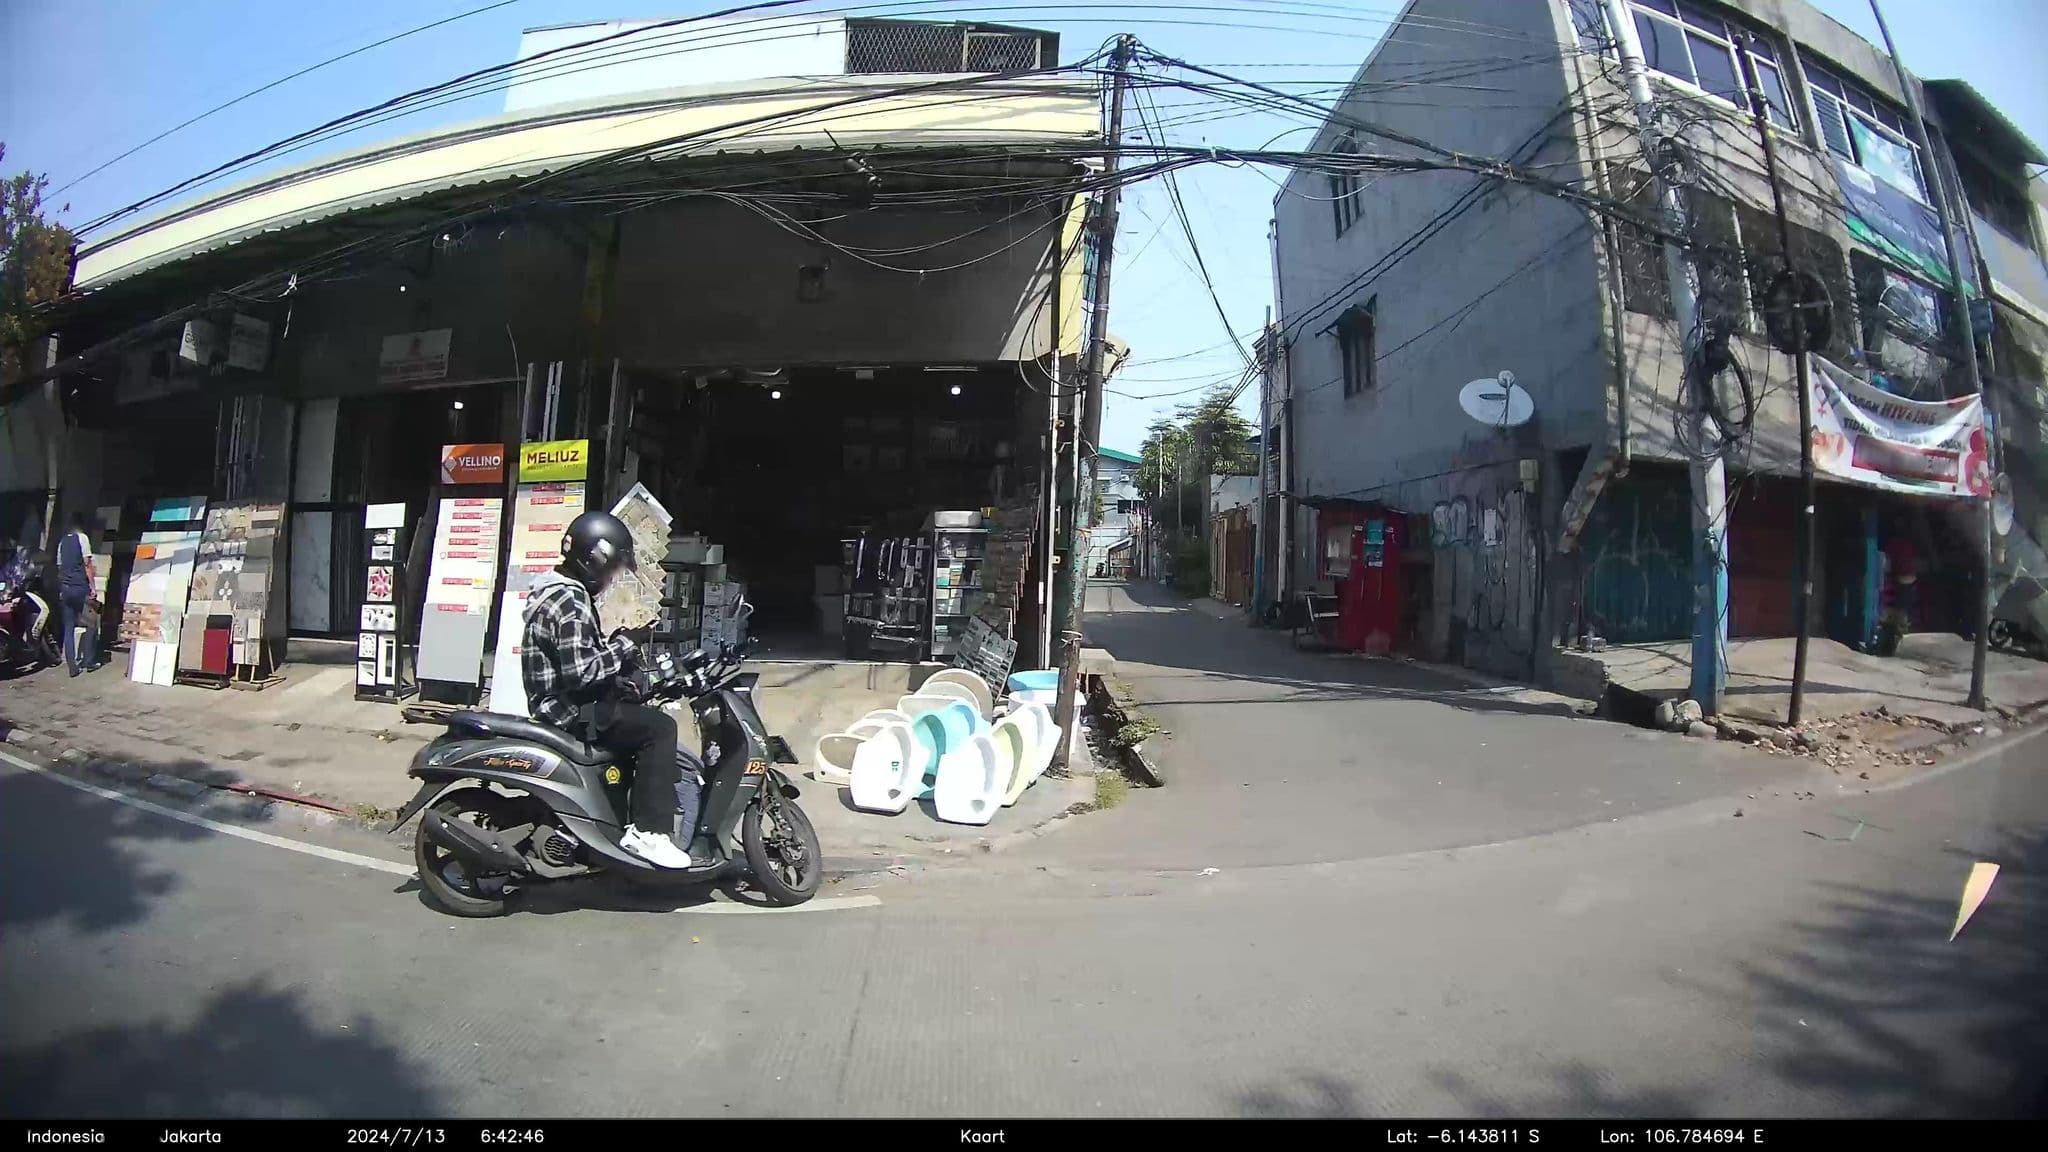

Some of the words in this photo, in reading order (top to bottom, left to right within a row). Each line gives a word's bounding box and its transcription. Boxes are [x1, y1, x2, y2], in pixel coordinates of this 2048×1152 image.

[458, 455, 501, 467] VELLINO
[527, 450, 579, 464] MELIUZ
[744, 761, 766, 775] 125
